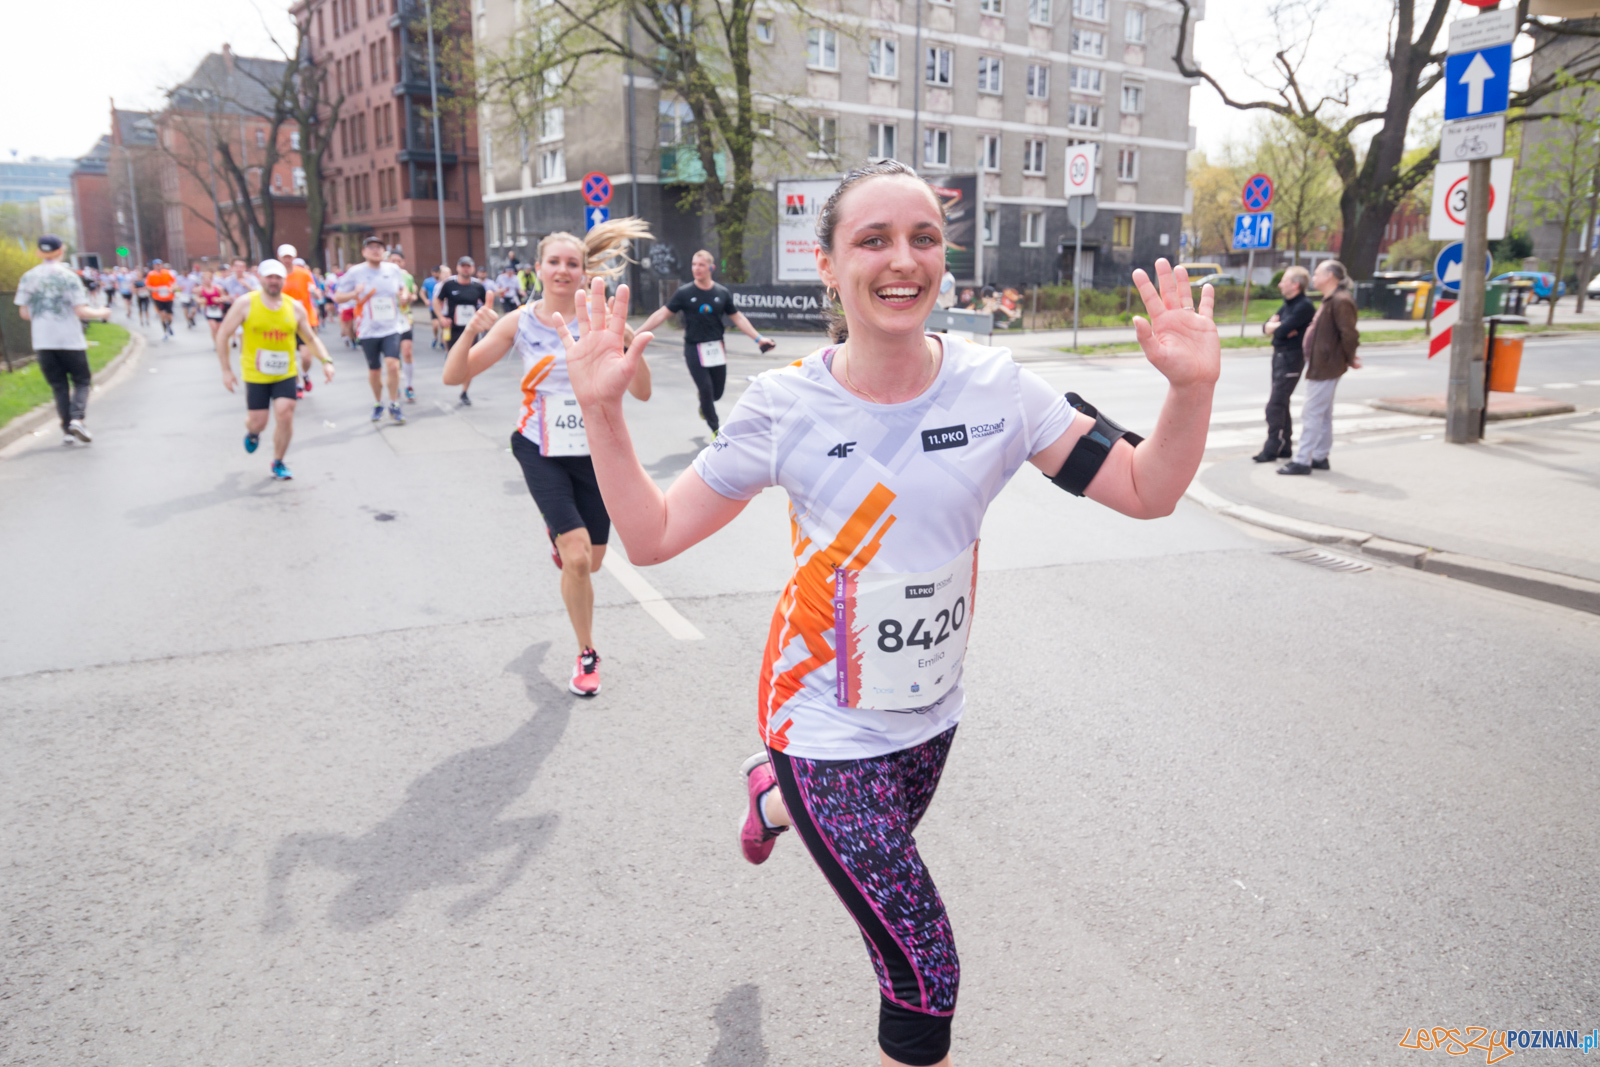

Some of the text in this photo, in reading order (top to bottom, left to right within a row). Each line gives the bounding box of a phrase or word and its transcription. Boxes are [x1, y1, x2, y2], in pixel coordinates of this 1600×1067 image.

[1073, 162, 1087, 177] 30
[1452, 189, 1468, 212] 3
[733, 292, 818, 311] RESTAURACJA
[941, 430, 964, 444] PKO
[827, 441, 857, 458] 4F
[918, 587, 934, 595] PKO
[877, 596, 965, 653] 8420
[918, 651, 945, 669] Emilia
